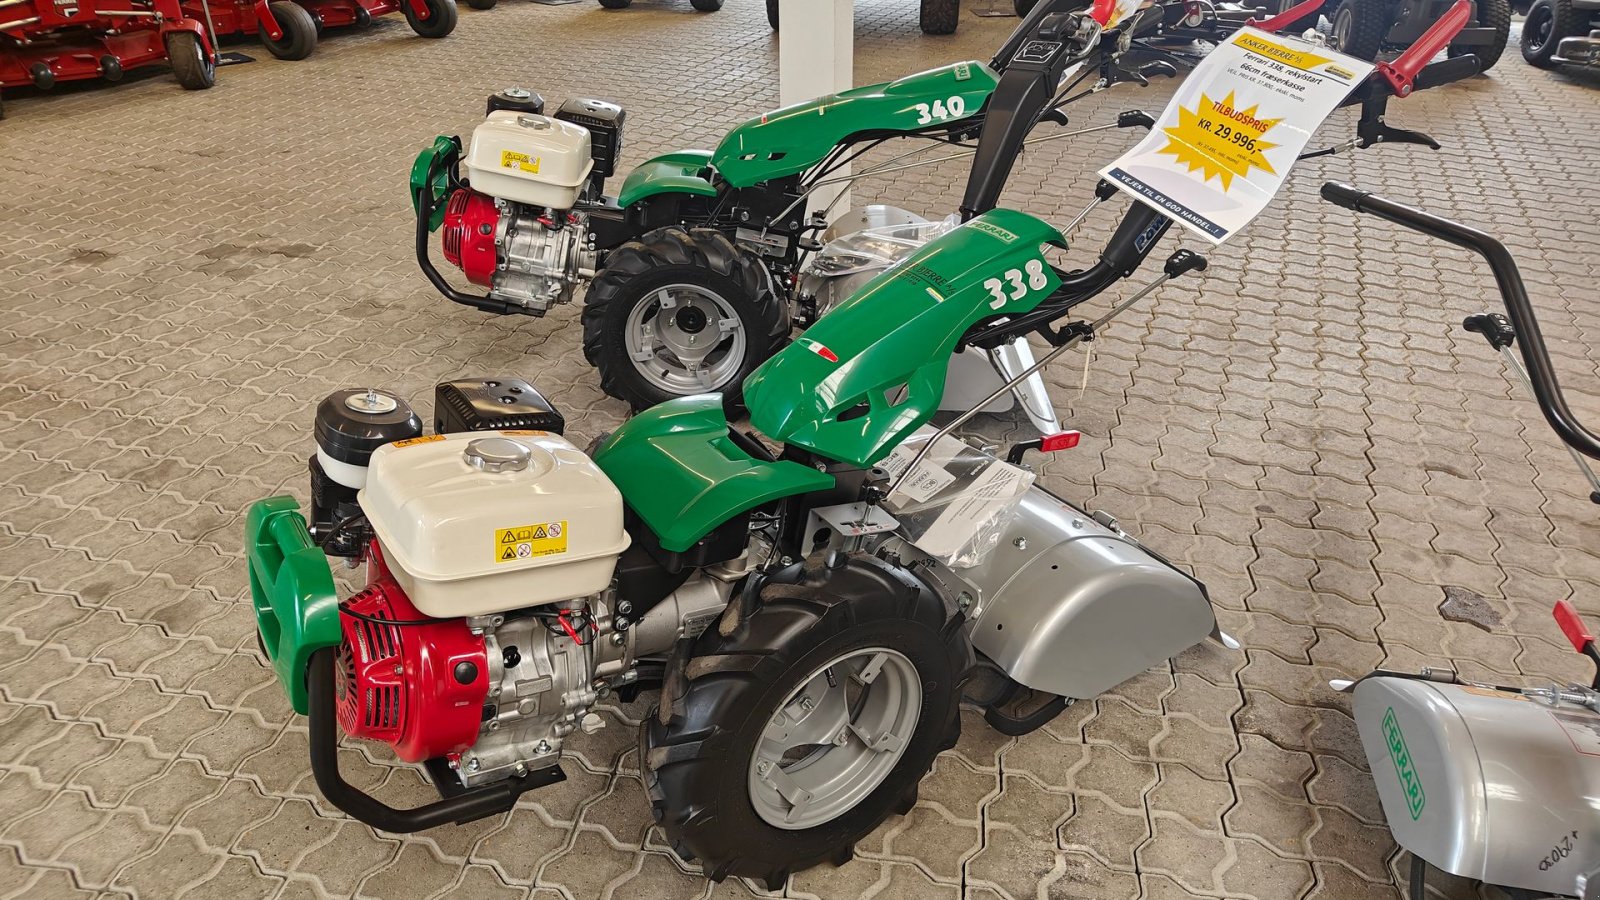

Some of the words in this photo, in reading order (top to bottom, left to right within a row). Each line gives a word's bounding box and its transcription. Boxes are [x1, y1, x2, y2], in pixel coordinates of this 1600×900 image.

[1240, 38, 1268, 50] ANKER
[1267, 45, 1296, 61] BJERRE
[1240, 62, 1261, 75] 66cm
[1260, 68, 1306, 92] fræserkasse
[1243, 52, 1268, 65] Ferrari
[1268, 60, 1284, 72] 338,
[1284, 68, 1323, 85] rekylstart
[915, 96, 964, 124] 340
[1212, 101, 1269, 133] TILBUDSPRIS
[1197, 118, 1212, 132] KR.
[1214, 123, 1262, 155] 29.996,-
[1121, 175, 1144, 192] VEJEN
[1143, 187, 1154, 197] TIL
[1154, 193, 1167, 203] EN
[1165, 201, 1182, 213] GOD
[970, 220, 1015, 241] FERRARI
[983, 259, 1048, 310] 338
[1384, 714, 1422, 812] FERRARI
